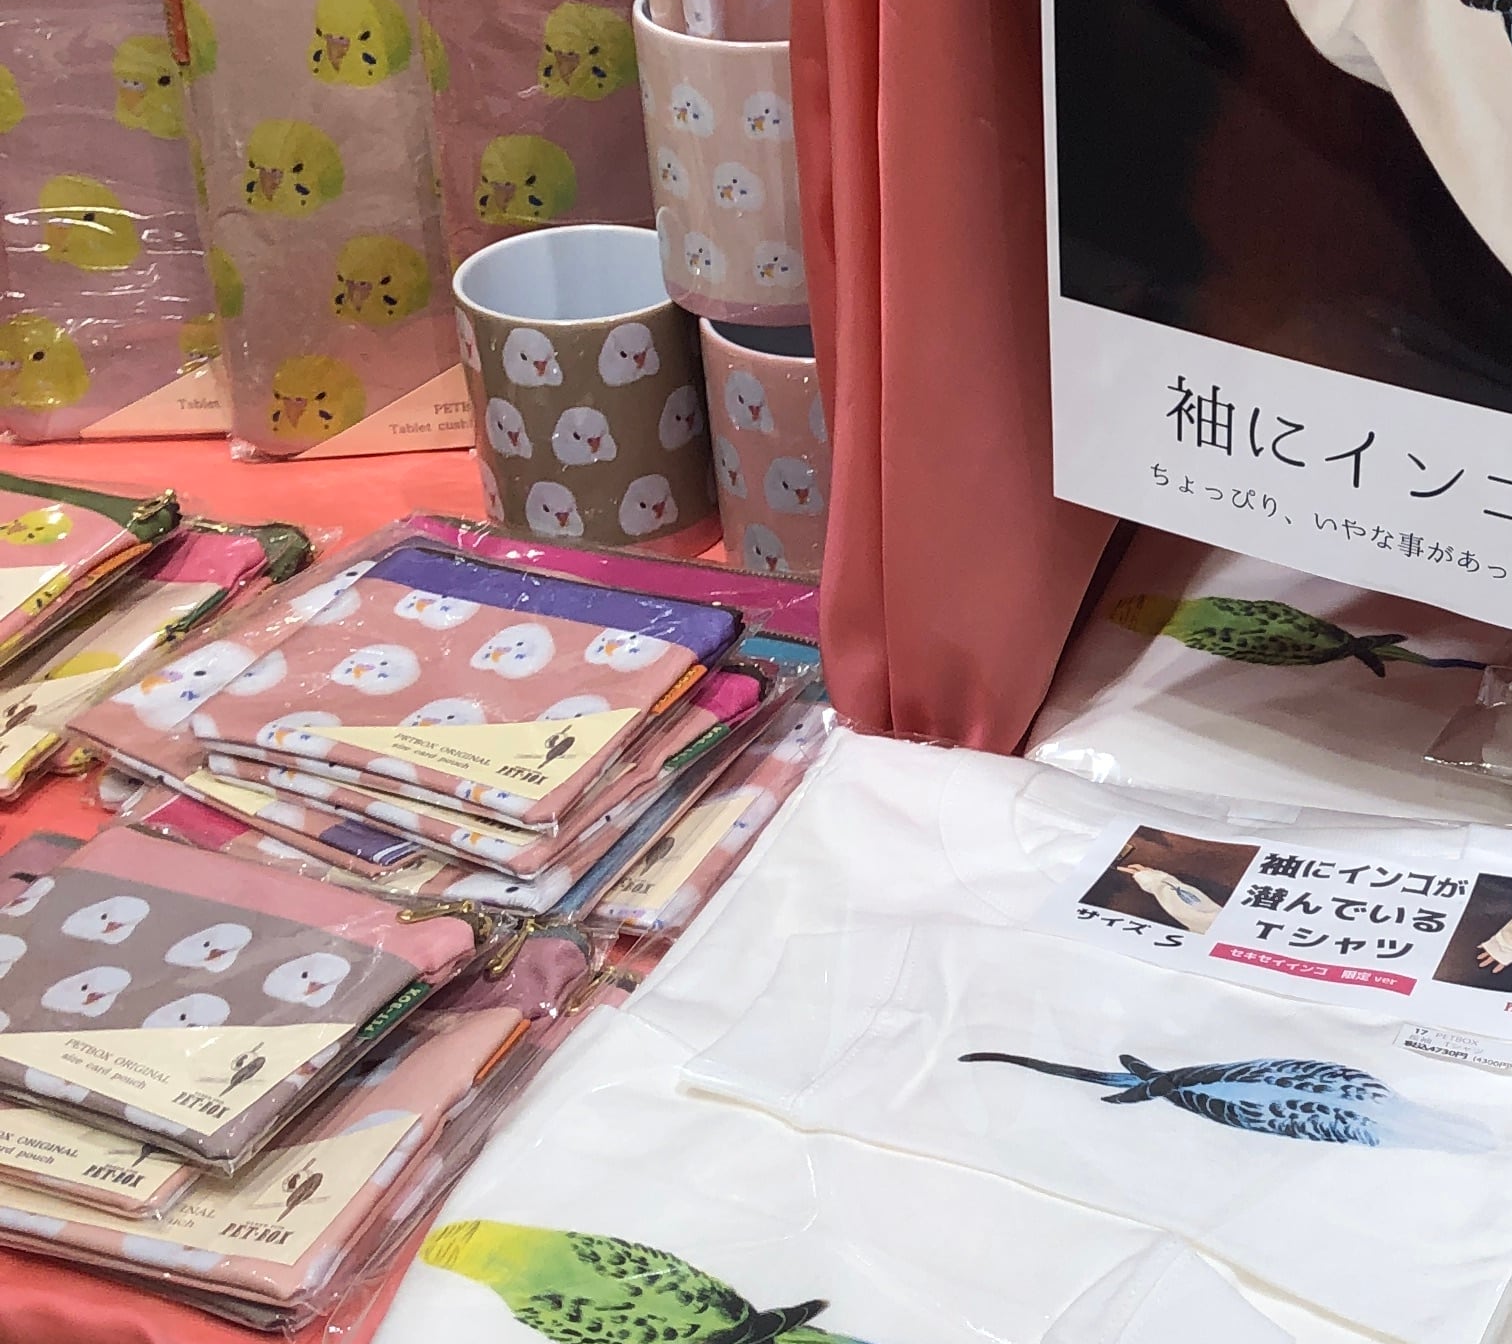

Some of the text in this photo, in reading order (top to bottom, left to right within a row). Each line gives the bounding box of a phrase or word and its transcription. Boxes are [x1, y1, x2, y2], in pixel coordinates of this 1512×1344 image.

[388, 422, 432, 434] Tablet
[1258, 853, 1469, 900] 袖にインコが
[1075, 908, 1152, 936] サイズ
[1240, 883, 1448, 934] 潜んでいる
[1253, 919, 1415, 960] Tシャツ
[1229, 947, 1398, 987] セキセイインコ 限定 ver
[1415, 1028, 1480, 1046] 17 PETBOX
[65, 1038, 169, 1085] PETBOX ORIGINAL
[171, 1091, 230, 1119] PET-BOX
[15, 1149, 55, 1164] pouch
[16, 1135, 79, 1158] ORIGINAL
[83, 1164, 146, 1188] PET-BOX
[220, 1222, 294, 1245] PET-BOX
